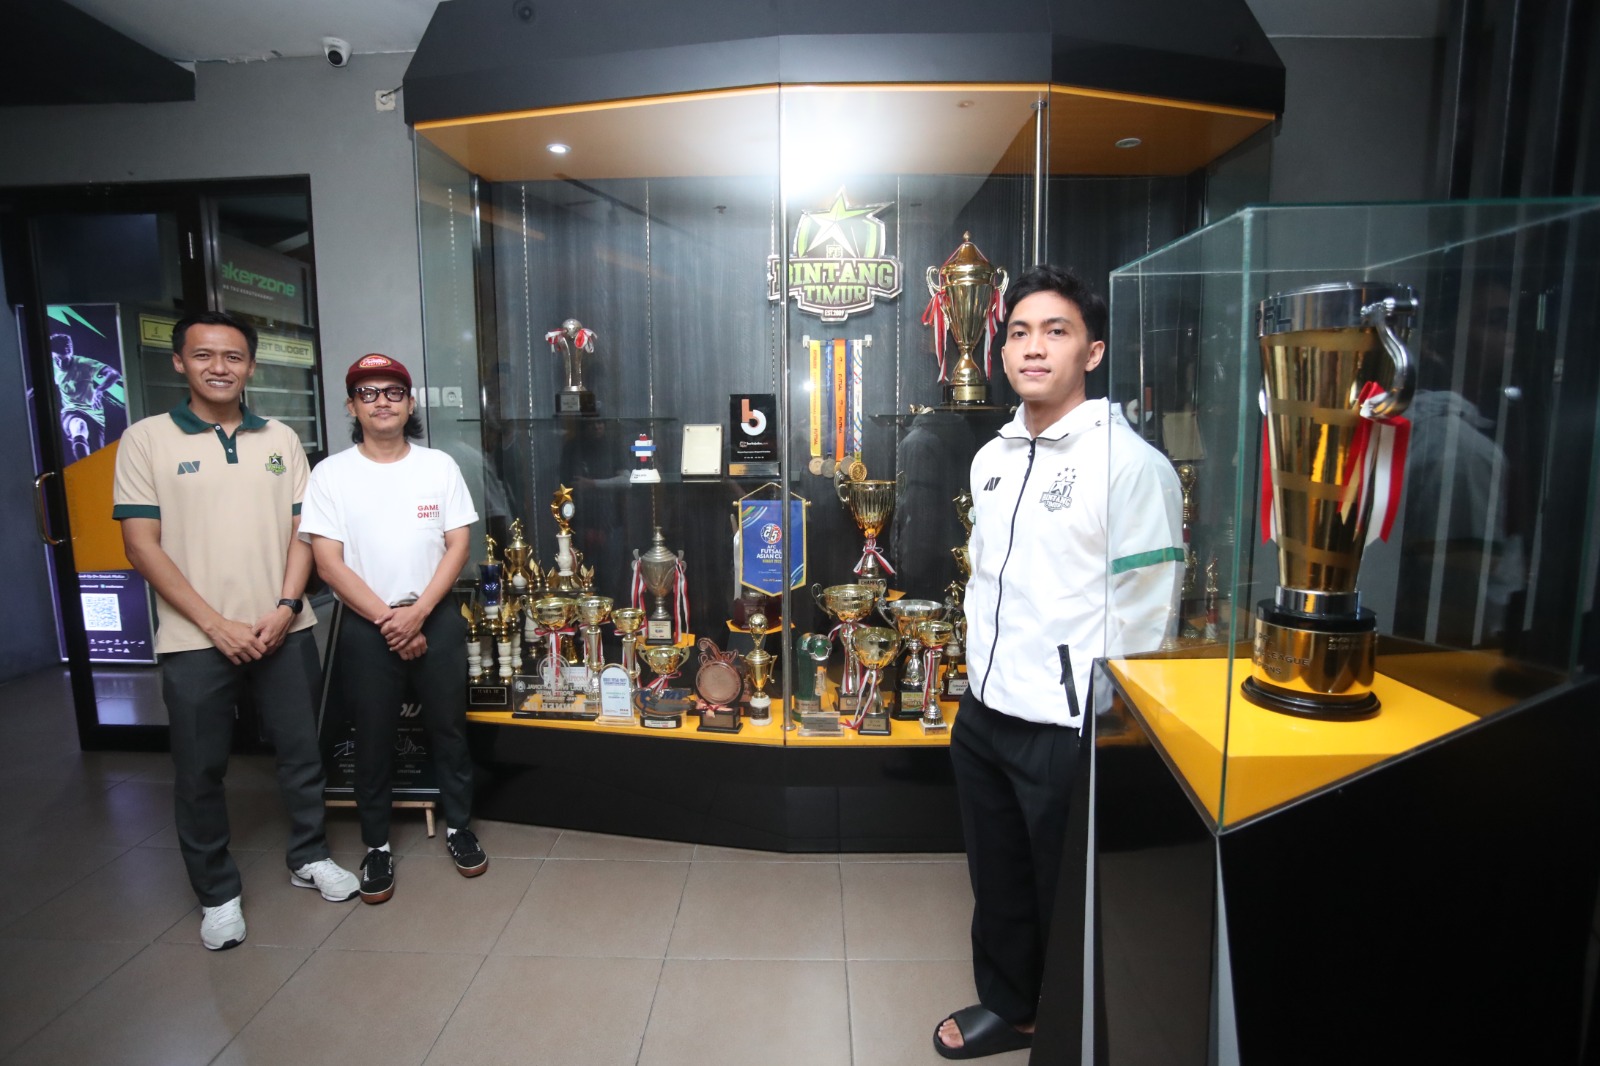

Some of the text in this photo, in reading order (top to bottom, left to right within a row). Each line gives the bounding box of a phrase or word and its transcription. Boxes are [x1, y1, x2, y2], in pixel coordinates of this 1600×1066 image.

[221, 261, 296, 297] akerzone
[803, 285, 866, 304] TIMUR
[258, 341, 309, 356] EST BUDGET
